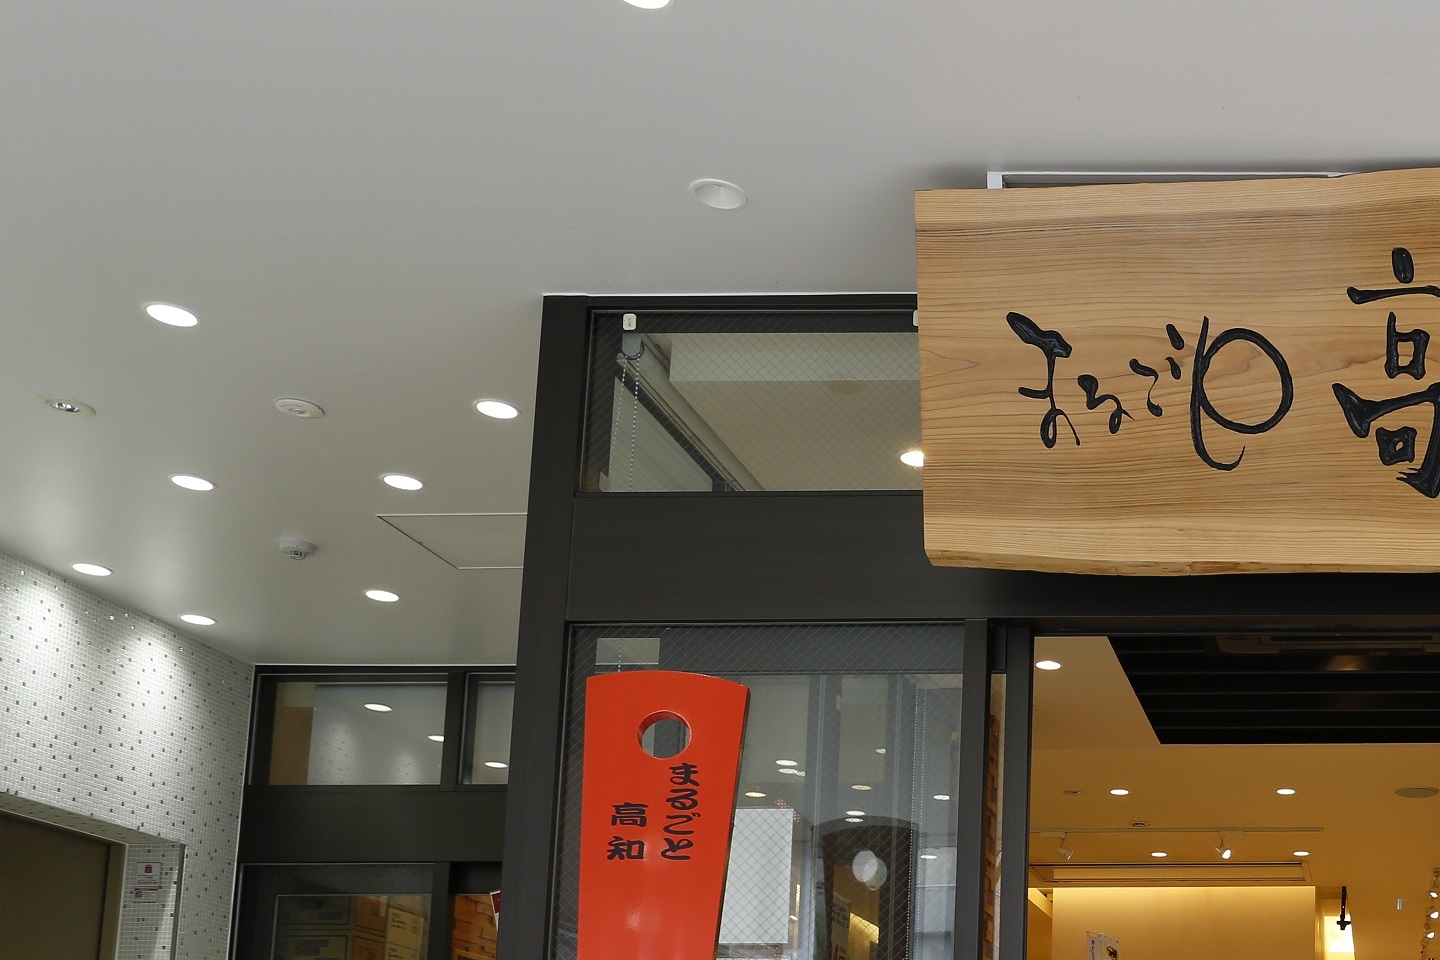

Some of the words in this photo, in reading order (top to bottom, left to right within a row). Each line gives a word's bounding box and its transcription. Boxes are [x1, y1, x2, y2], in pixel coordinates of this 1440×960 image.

[606, 801, 648, 861] 高知
[660, 761, 700, 861] まるごと
